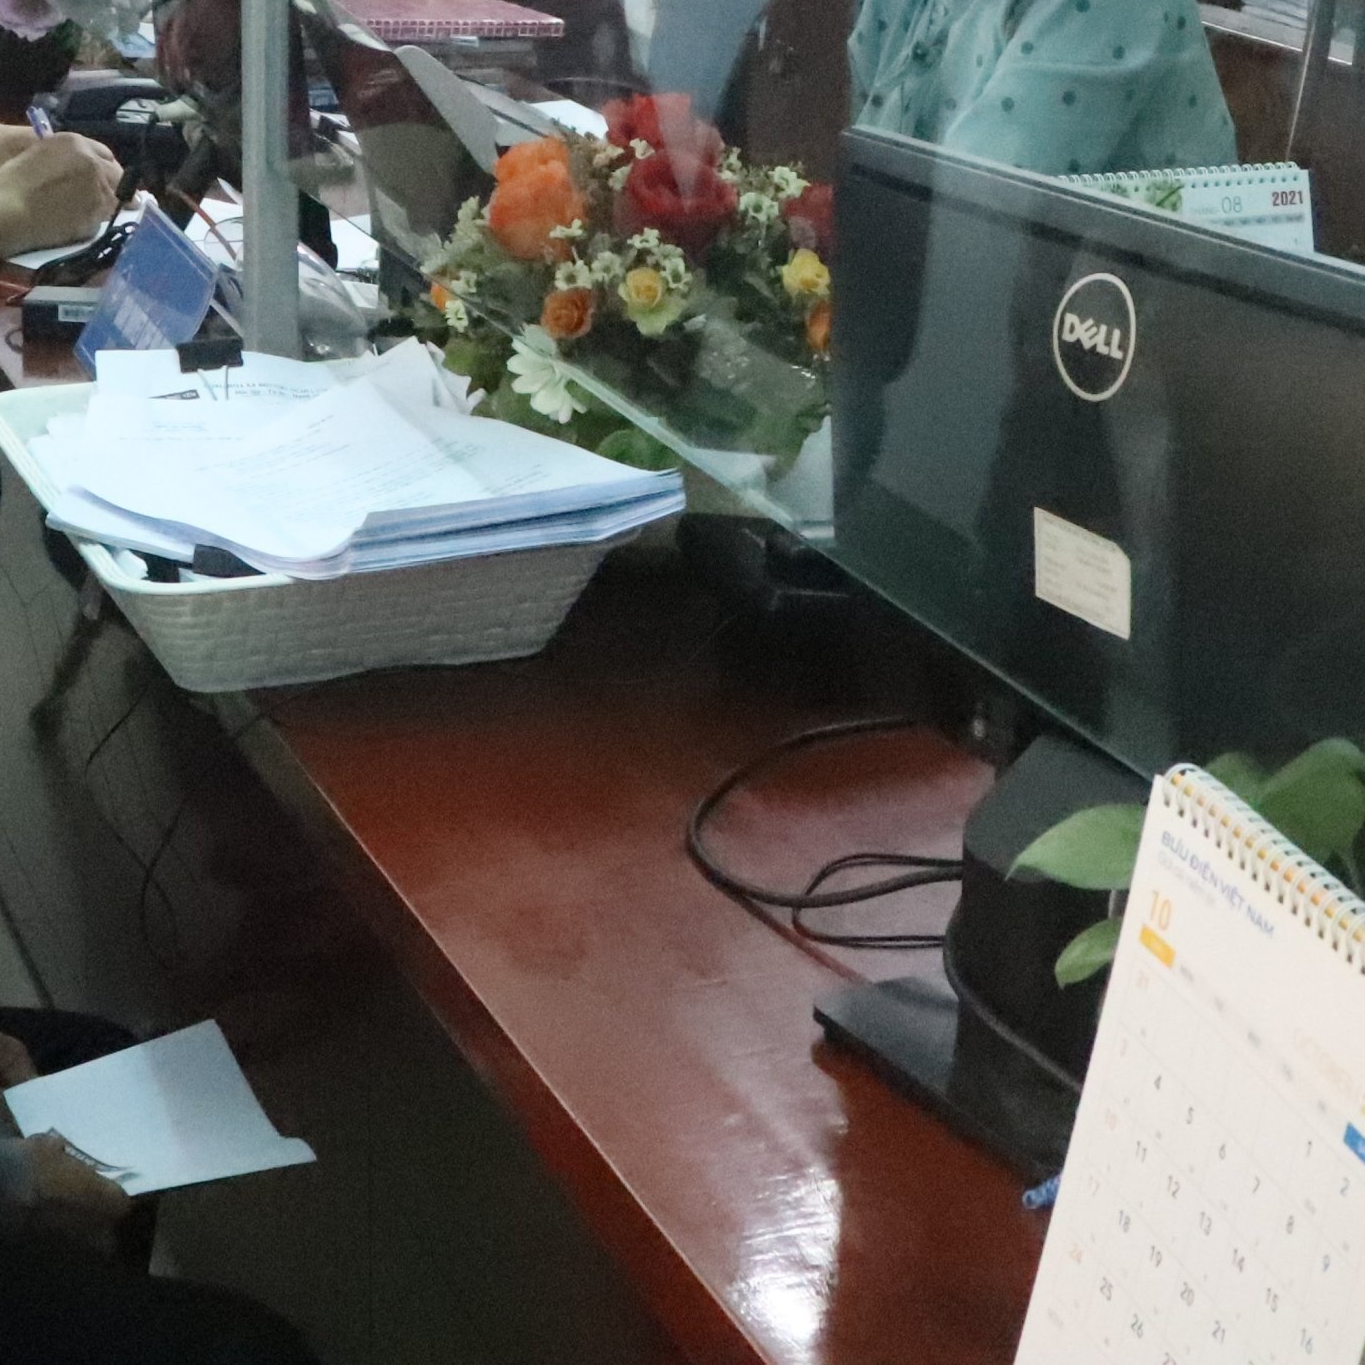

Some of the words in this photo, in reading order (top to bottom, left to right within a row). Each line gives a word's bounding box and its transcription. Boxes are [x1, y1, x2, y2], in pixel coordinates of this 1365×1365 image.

[1221, 196, 1243, 214] 08
[1272, 190, 1304, 207] 2021
[1062, 311, 1124, 360] DELL
[1150, 889, 1172, 932] 10
[1246, 907, 1275, 938] NAM
[1153, 1074, 1162, 1091] 4
[1186, 1106, 1195, 1125] 5
[1218, 1142, 1227, 1160] 6
[1252, 1176, 1260, 1194] 7
[1286, 1215, 1295, 1235] 8
[1322, 1254, 1330, 1273] 9
[1306, 1140, 1313, 1158] 1
[1340, 1177, 1350, 1197] 2
[1135, 1140, 1148, 1164] 11
[1166, 1175, 1181, 1199] 12
[1199, 1211, 1213, 1236] 13
[1232, 1248, 1246, 1273] 14
[1265, 1287, 1279, 1313] 15
[1300, 1328, 1314, 1355] 16
[1118, 1209, 1131, 1234] 18
[1149, 1245, 1163, 1268] 19
[1179, 1282, 1195, 1307] 20
[1212, 1320, 1226, 1345] 21
[1099, 1277, 1114, 1301] 25
[1130, 1313, 1144, 1340] 26
